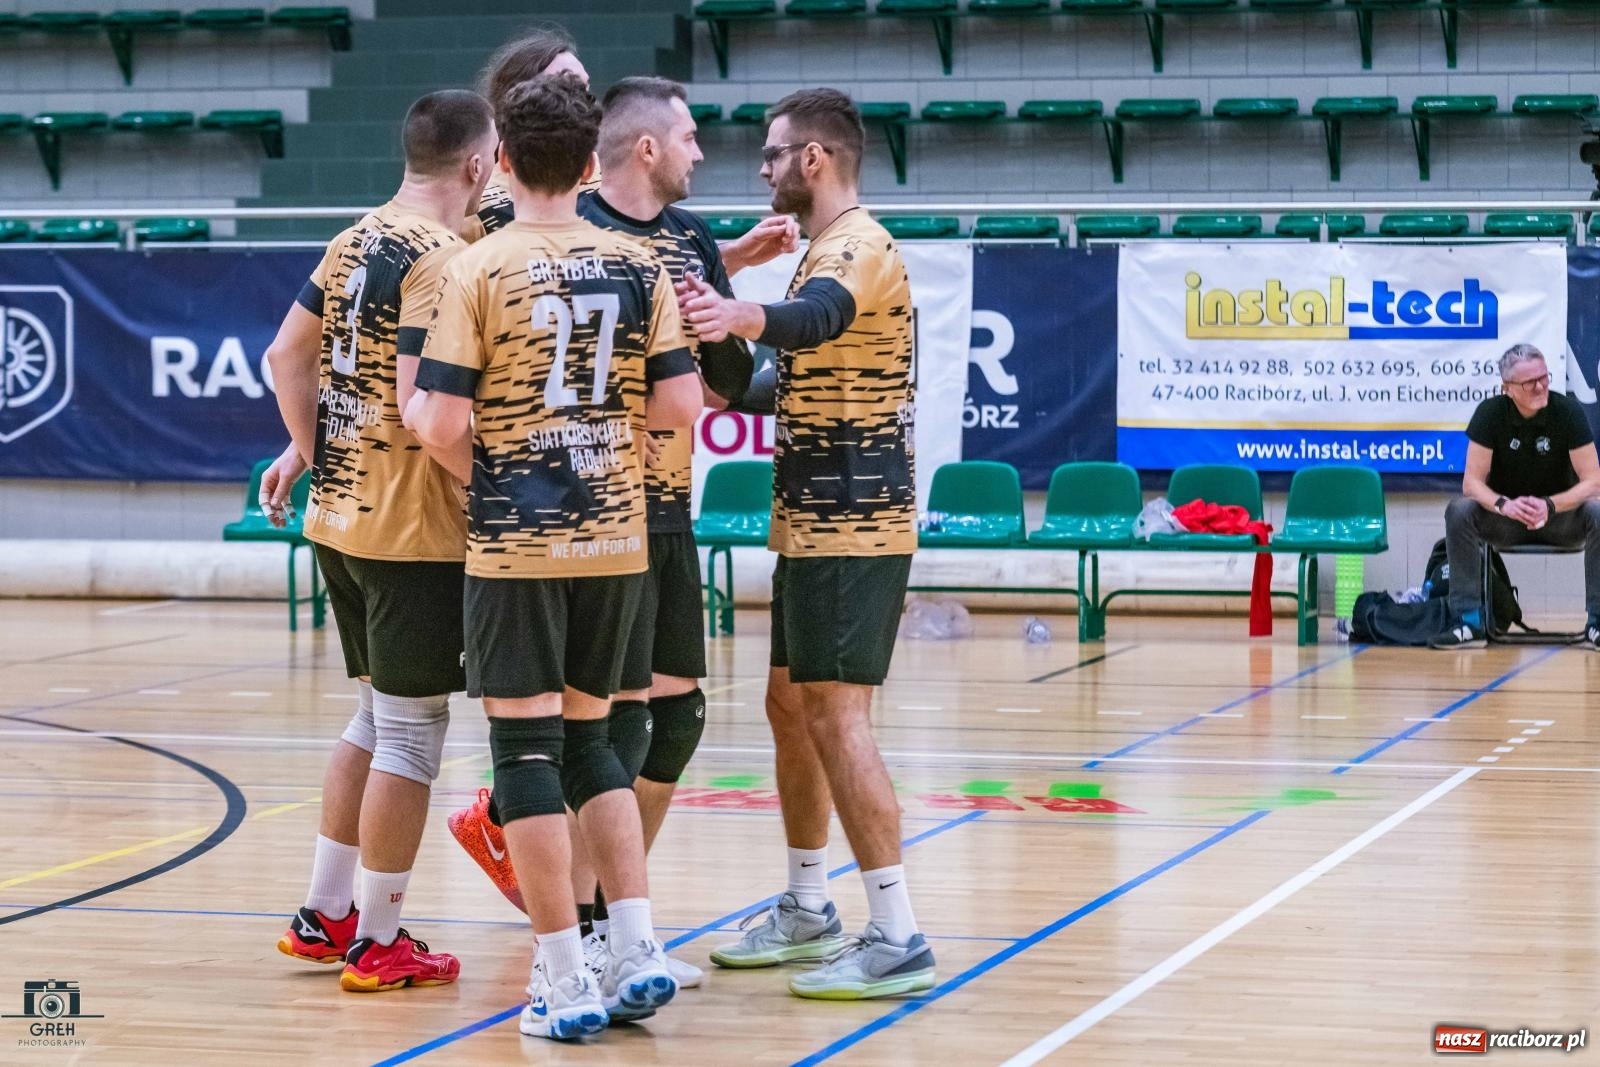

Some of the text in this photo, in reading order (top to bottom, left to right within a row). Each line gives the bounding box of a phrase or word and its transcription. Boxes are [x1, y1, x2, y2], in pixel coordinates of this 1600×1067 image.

[527, 257, 608, 282] GRZYBEK
[1185, 271, 1499, 340] instal-tech
[531, 293, 620, 408] 27
[150, 336, 275, 399] RA
[1139, 358, 1167, 375] tel.
[1172, 359, 1193, 375] 32
[1200, 359, 1234, 375] 414
[1239, 359, 1260, 376] 92
[1266, 359, 1293, 377] 88,
[1304, 360, 1336, 377] 502
[1342, 360, 1375, 377] 632
[1381, 360, 1421, 378] 695,
[1431, 360, 1466, 376] 606
[1152, 384, 1502, 404] 47-400 Racibórz, ul. J. von Eichendorf
[692, 411, 776, 454] OL
[1237, 438, 1444, 465] www.instal-tech.pl
[552, 543, 569, 558] WE
[572, 540, 600, 558] PLAY
[603, 539, 625, 555] FOR
